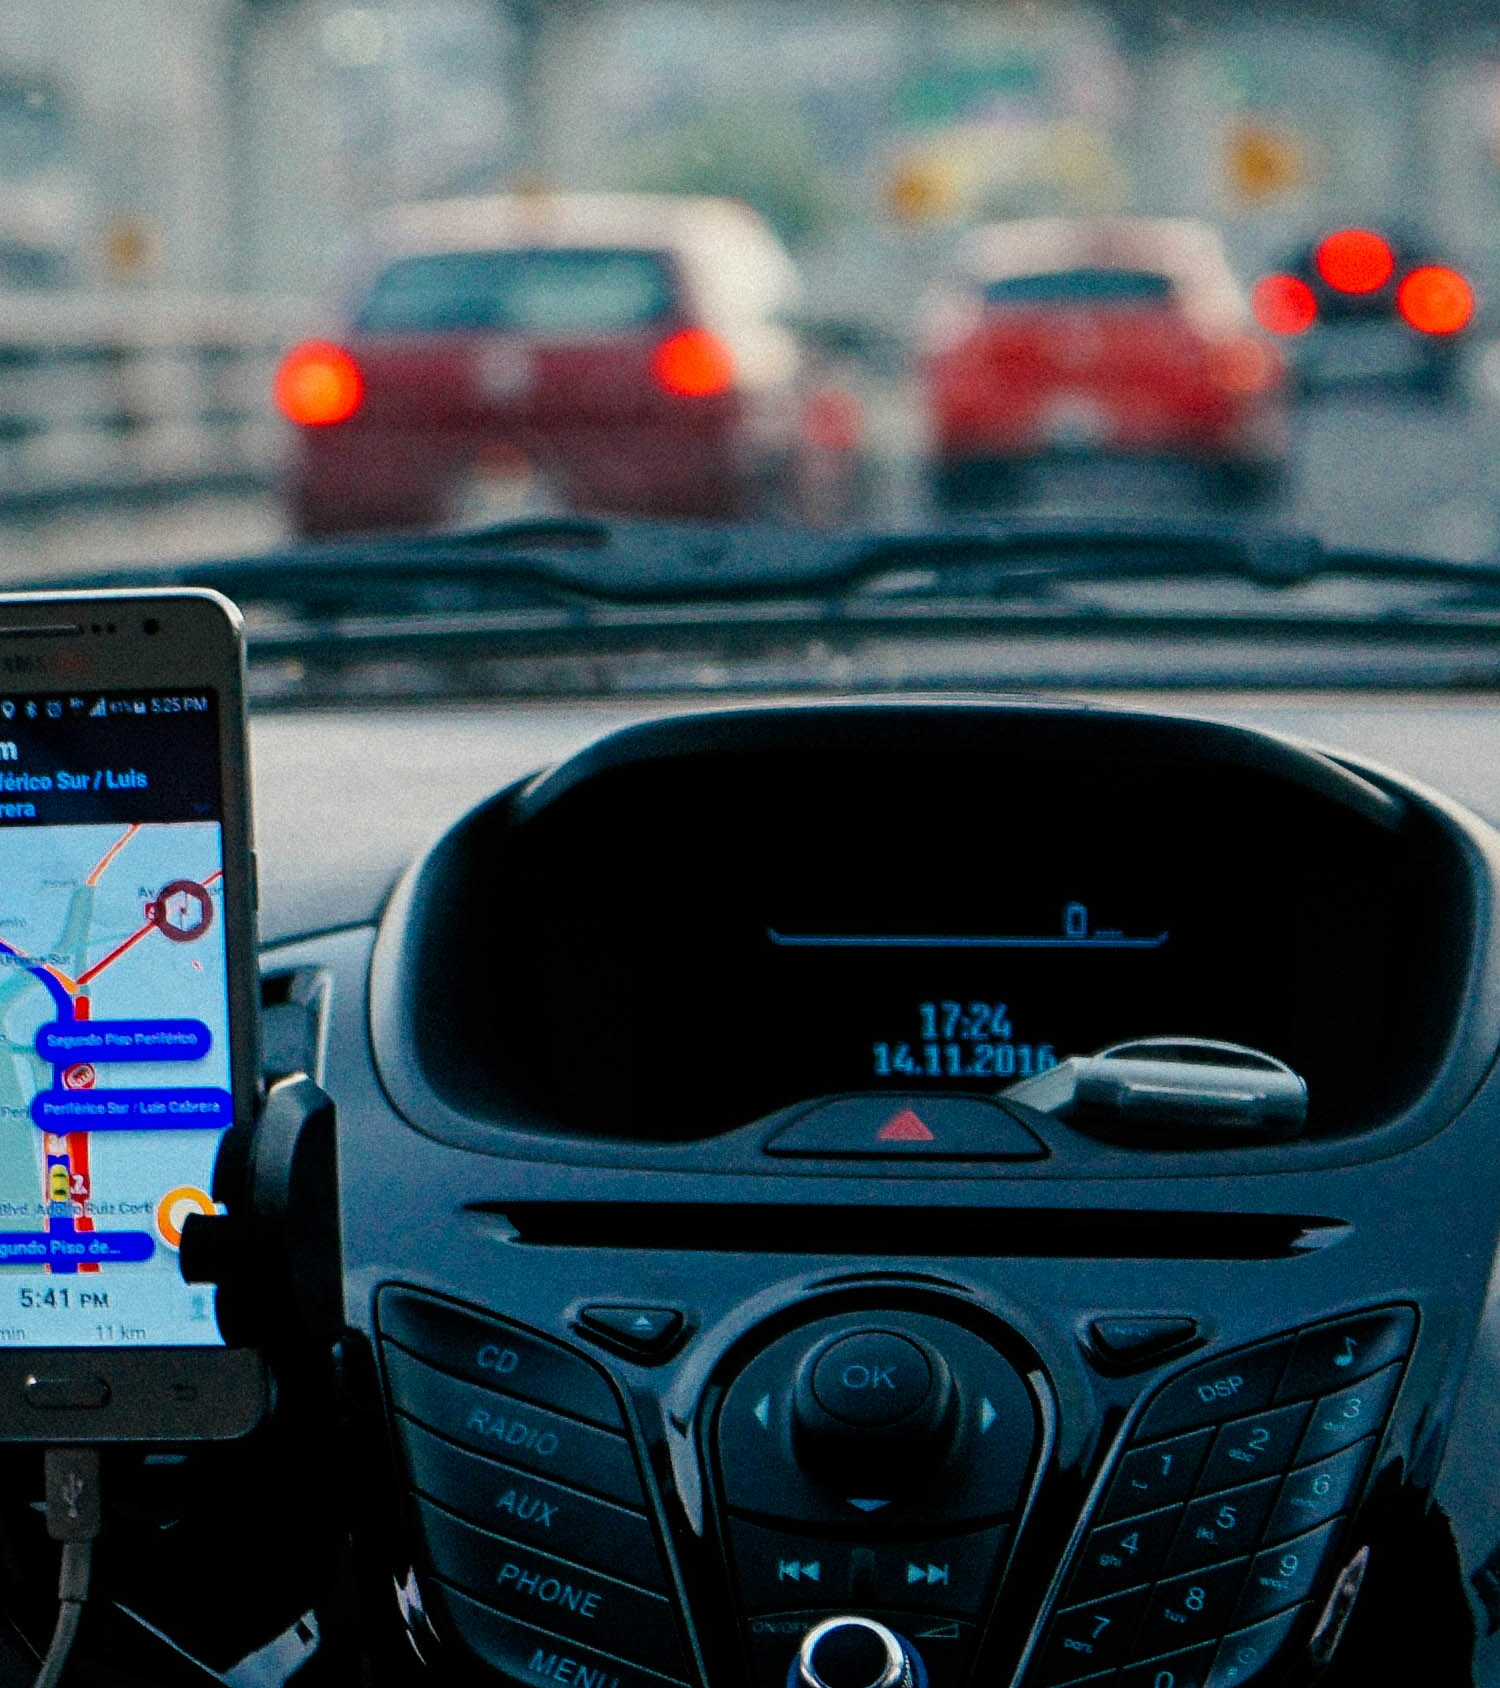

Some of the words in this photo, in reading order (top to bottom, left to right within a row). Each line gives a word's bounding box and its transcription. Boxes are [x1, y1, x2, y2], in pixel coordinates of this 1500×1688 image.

[56, 771, 91, 792] Sur
[92, 771, 103, 792] /
[105, 769, 149, 790] Luis
[917, 1001, 1012, 1041] 17:24
[872, 1042, 1058, 1078] 14.11.2016
[168, 1100, 221, 1114] Cabrera
[50, 1239, 85, 1255] Piso
[20, 1288, 70, 1308] 5:41
[80, 1293, 110, 1309] PM
[96, 1325, 116, 1340] 11
[120, 1324, 147, 1341] km
[475, 1345, 521, 1375] CD
[840, 1364, 896, 1391] OK
[1196, 1375, 1245, 1404] DSP
[1342, 1398, 1362, 1419] 3
[466, 1408, 560, 1456] RADIO
[1248, 1427, 1271, 1452] 2
[1159, 1454, 1175, 1477] 1
[1310, 1473, 1331, 1495] 6
[496, 1487, 559, 1530] AUX
[1216, 1505, 1238, 1530] 5
[1119, 1531, 1140, 1556] 4
[1278, 1553, 1299, 1578] 9
[496, 1561, 603, 1622] PHONE
[1184, 1585, 1207, 1612] 8
[1090, 1615, 1111, 1641] 7
[526, 1646, 621, 1688] MENU
